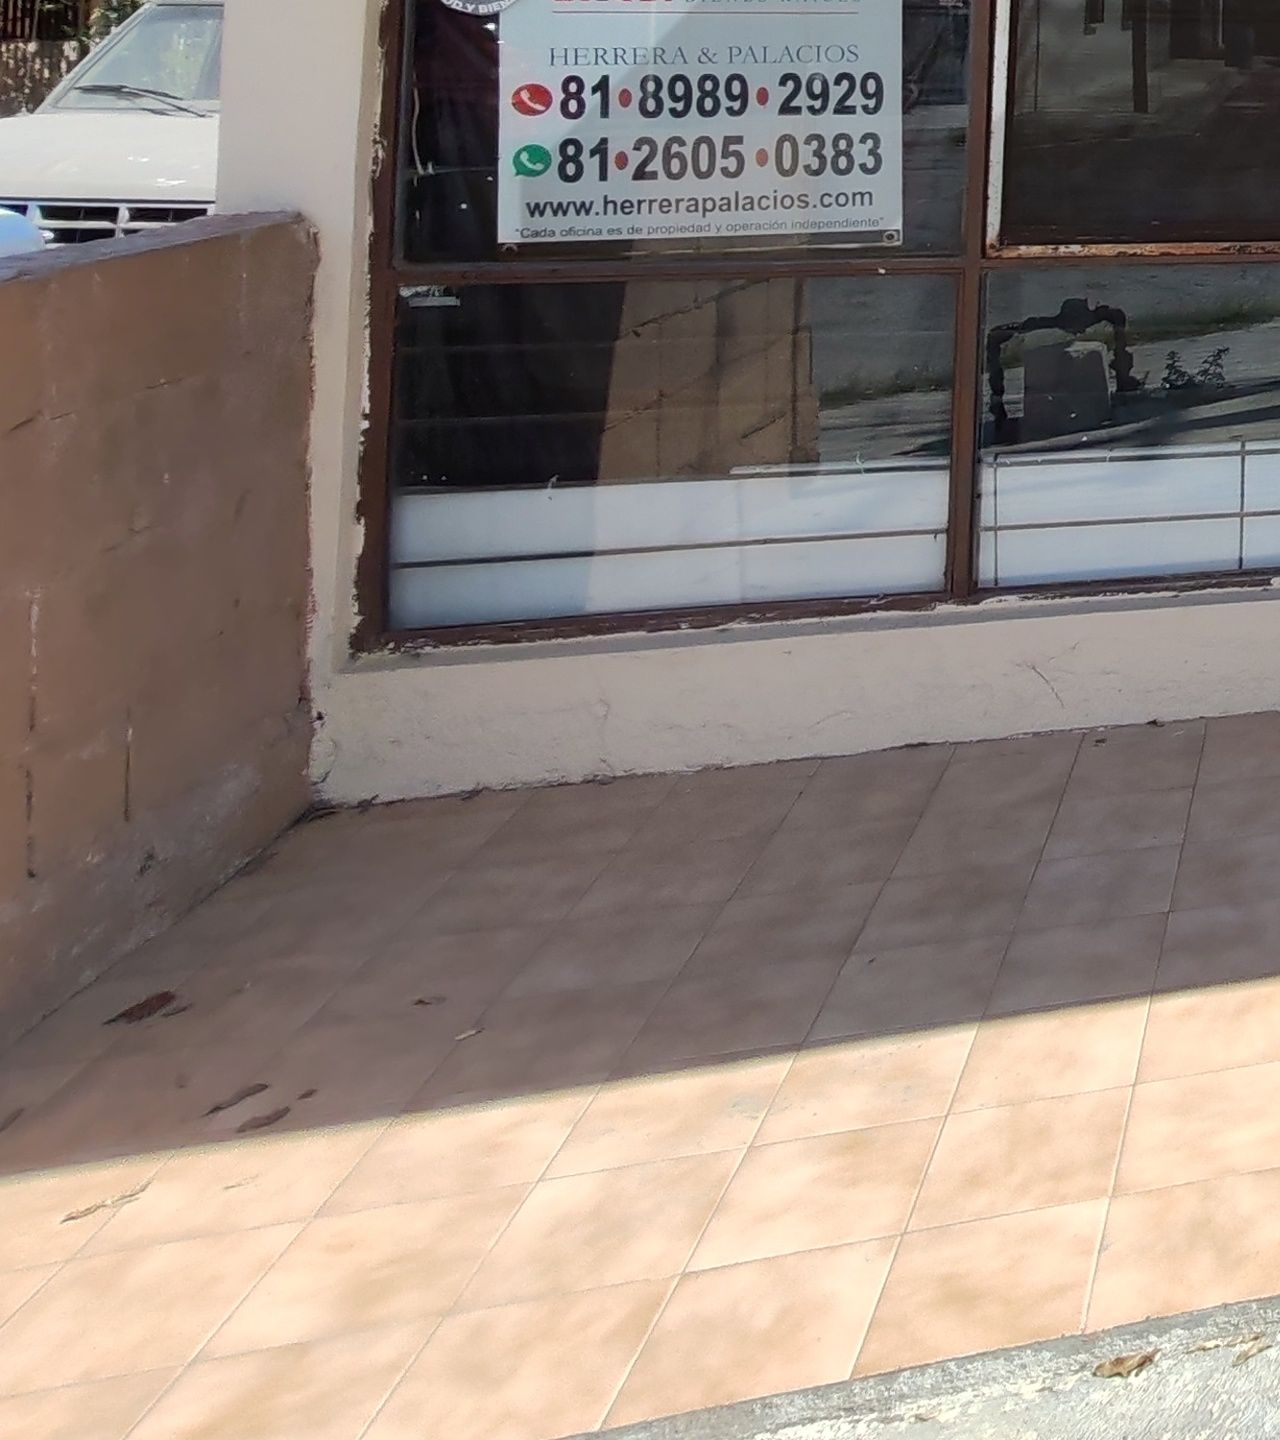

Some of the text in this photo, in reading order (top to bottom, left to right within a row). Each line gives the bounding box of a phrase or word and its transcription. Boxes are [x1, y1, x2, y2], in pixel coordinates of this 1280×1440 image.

[550, 44, 860, 67] HERRERA & PALACIOS
[525, 189, 874, 218] www.herrerapalacios.com
[560, 225, 603, 237] oficina
[607, 227, 623, 236] es
[627, 224, 644, 235] de
[647, 222, 712, 236] propiedad
[715, 223, 723, 233] y
[725, 219, 788, 233] operación
